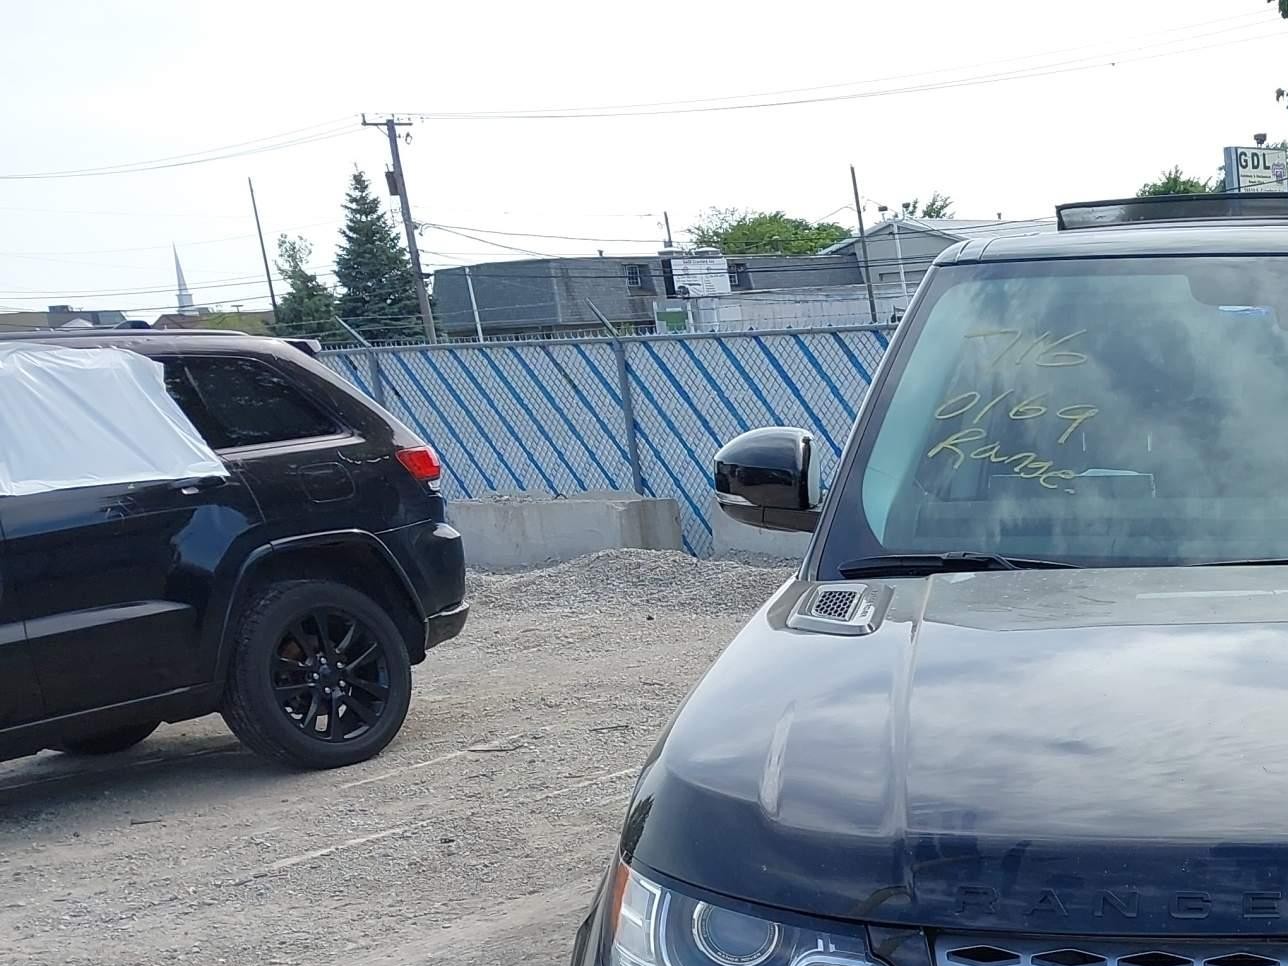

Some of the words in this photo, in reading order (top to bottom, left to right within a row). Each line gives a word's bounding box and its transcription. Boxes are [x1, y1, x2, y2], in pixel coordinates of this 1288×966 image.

[1239, 151, 1271, 170] GDL
[934, 388, 1099, 444] 0169
[954, 885, 1282, 919] RANGE
